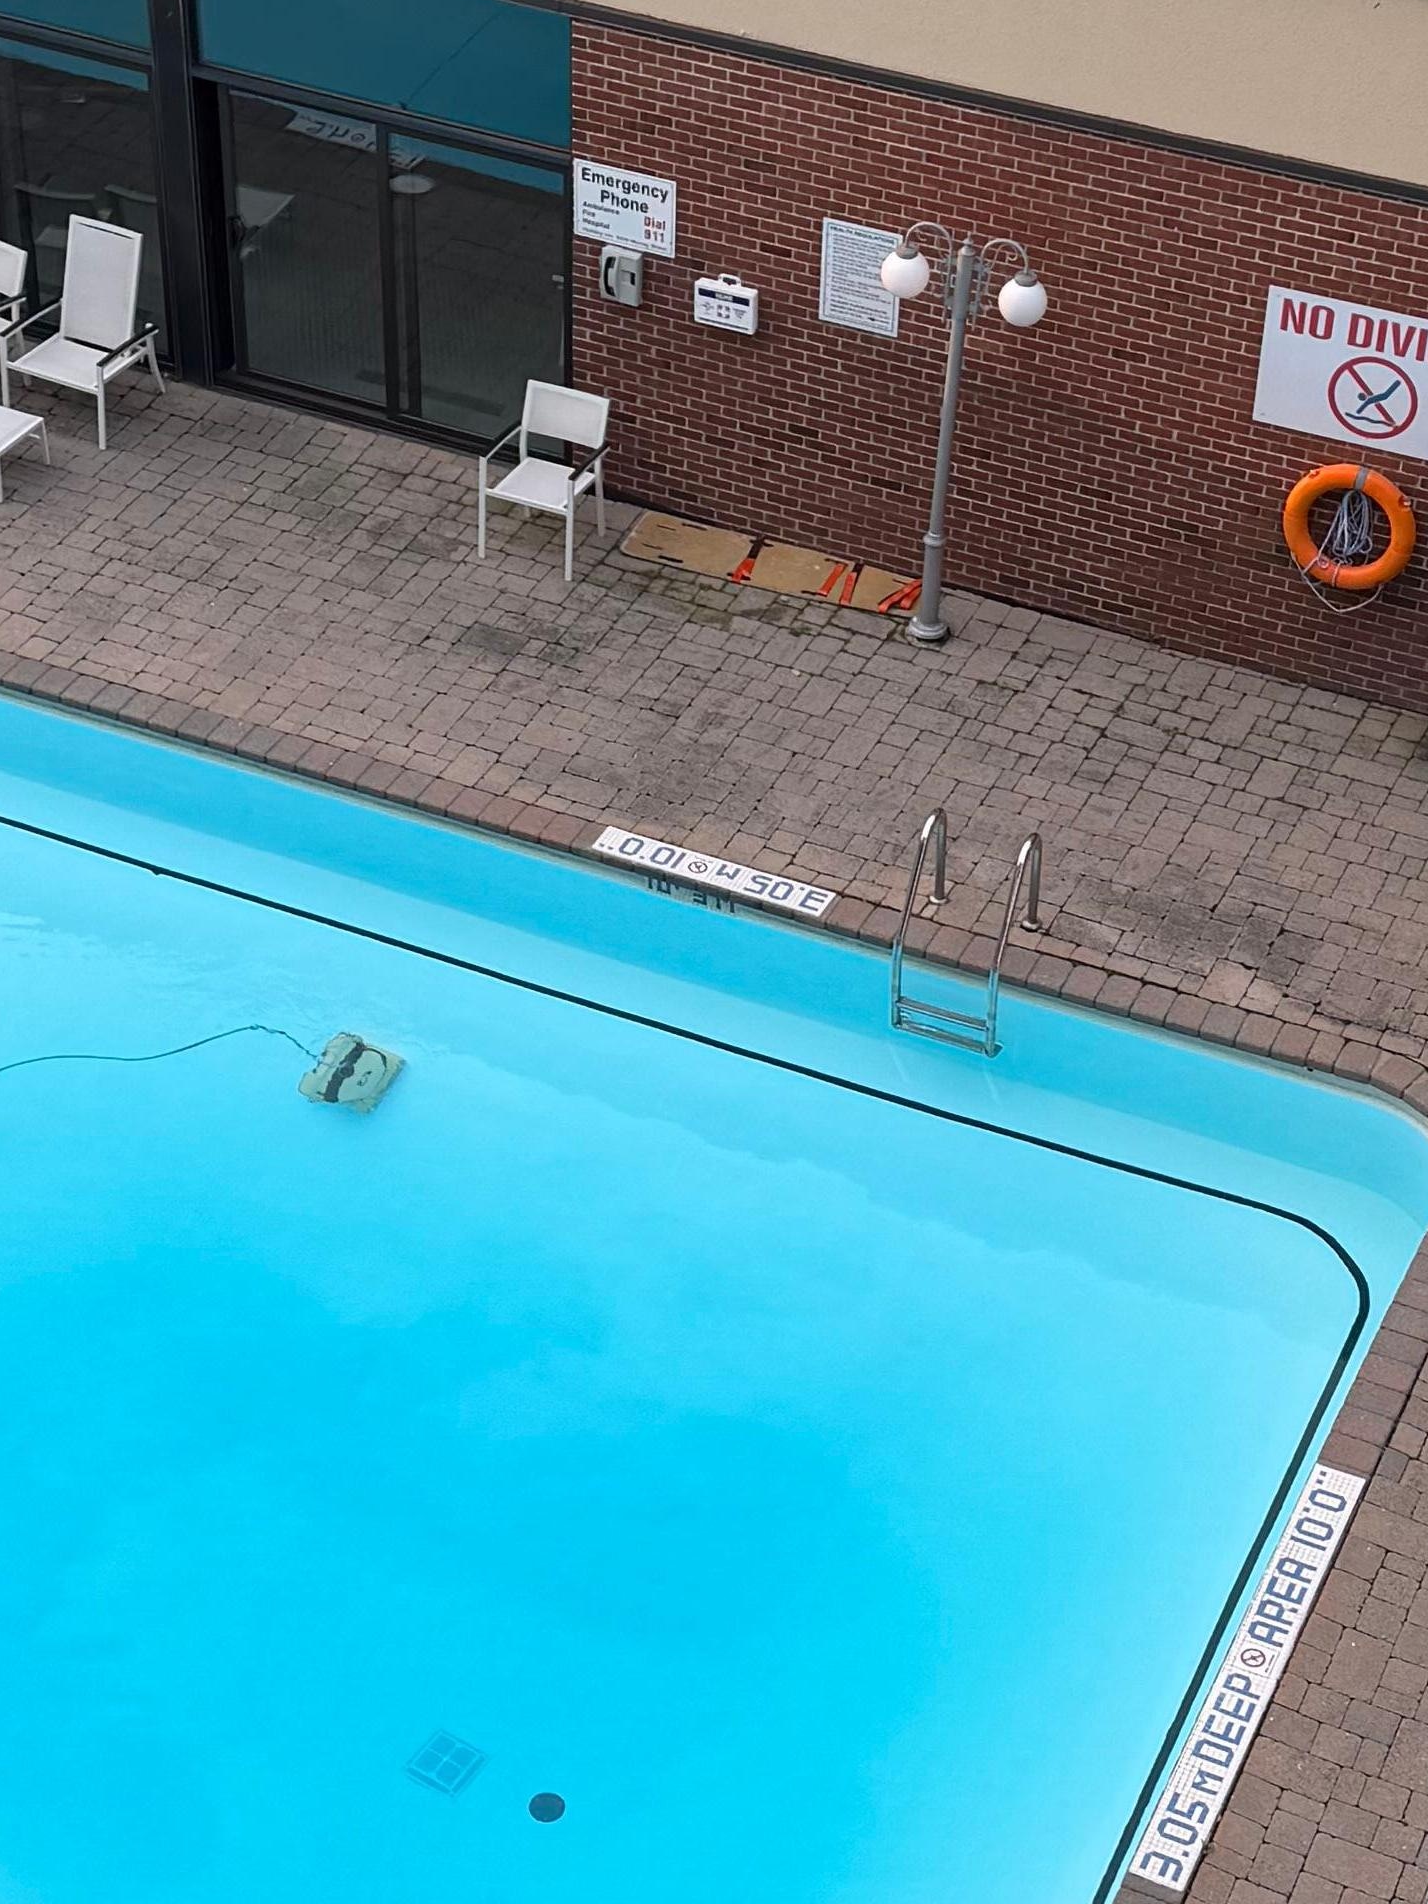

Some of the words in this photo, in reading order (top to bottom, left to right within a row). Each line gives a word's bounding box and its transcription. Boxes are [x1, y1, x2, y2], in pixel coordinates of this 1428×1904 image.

[581, 167, 668, 203] Emergency
[601, 190, 649, 213] Phone
[644, 216, 666, 231] Dial
[644, 229, 664, 243] 911
[1279, 298, 1335, 340] NO
[716, 863, 740, 880] M
[743, 874, 828, 912] 3.05
[1247, 1558, 1318, 1648] AREA
[1191, 1671, 1262, 1764] DEEP
[1193, 1769, 1225, 1796] M
[1140, 1791, 1208, 1882] 3.05
